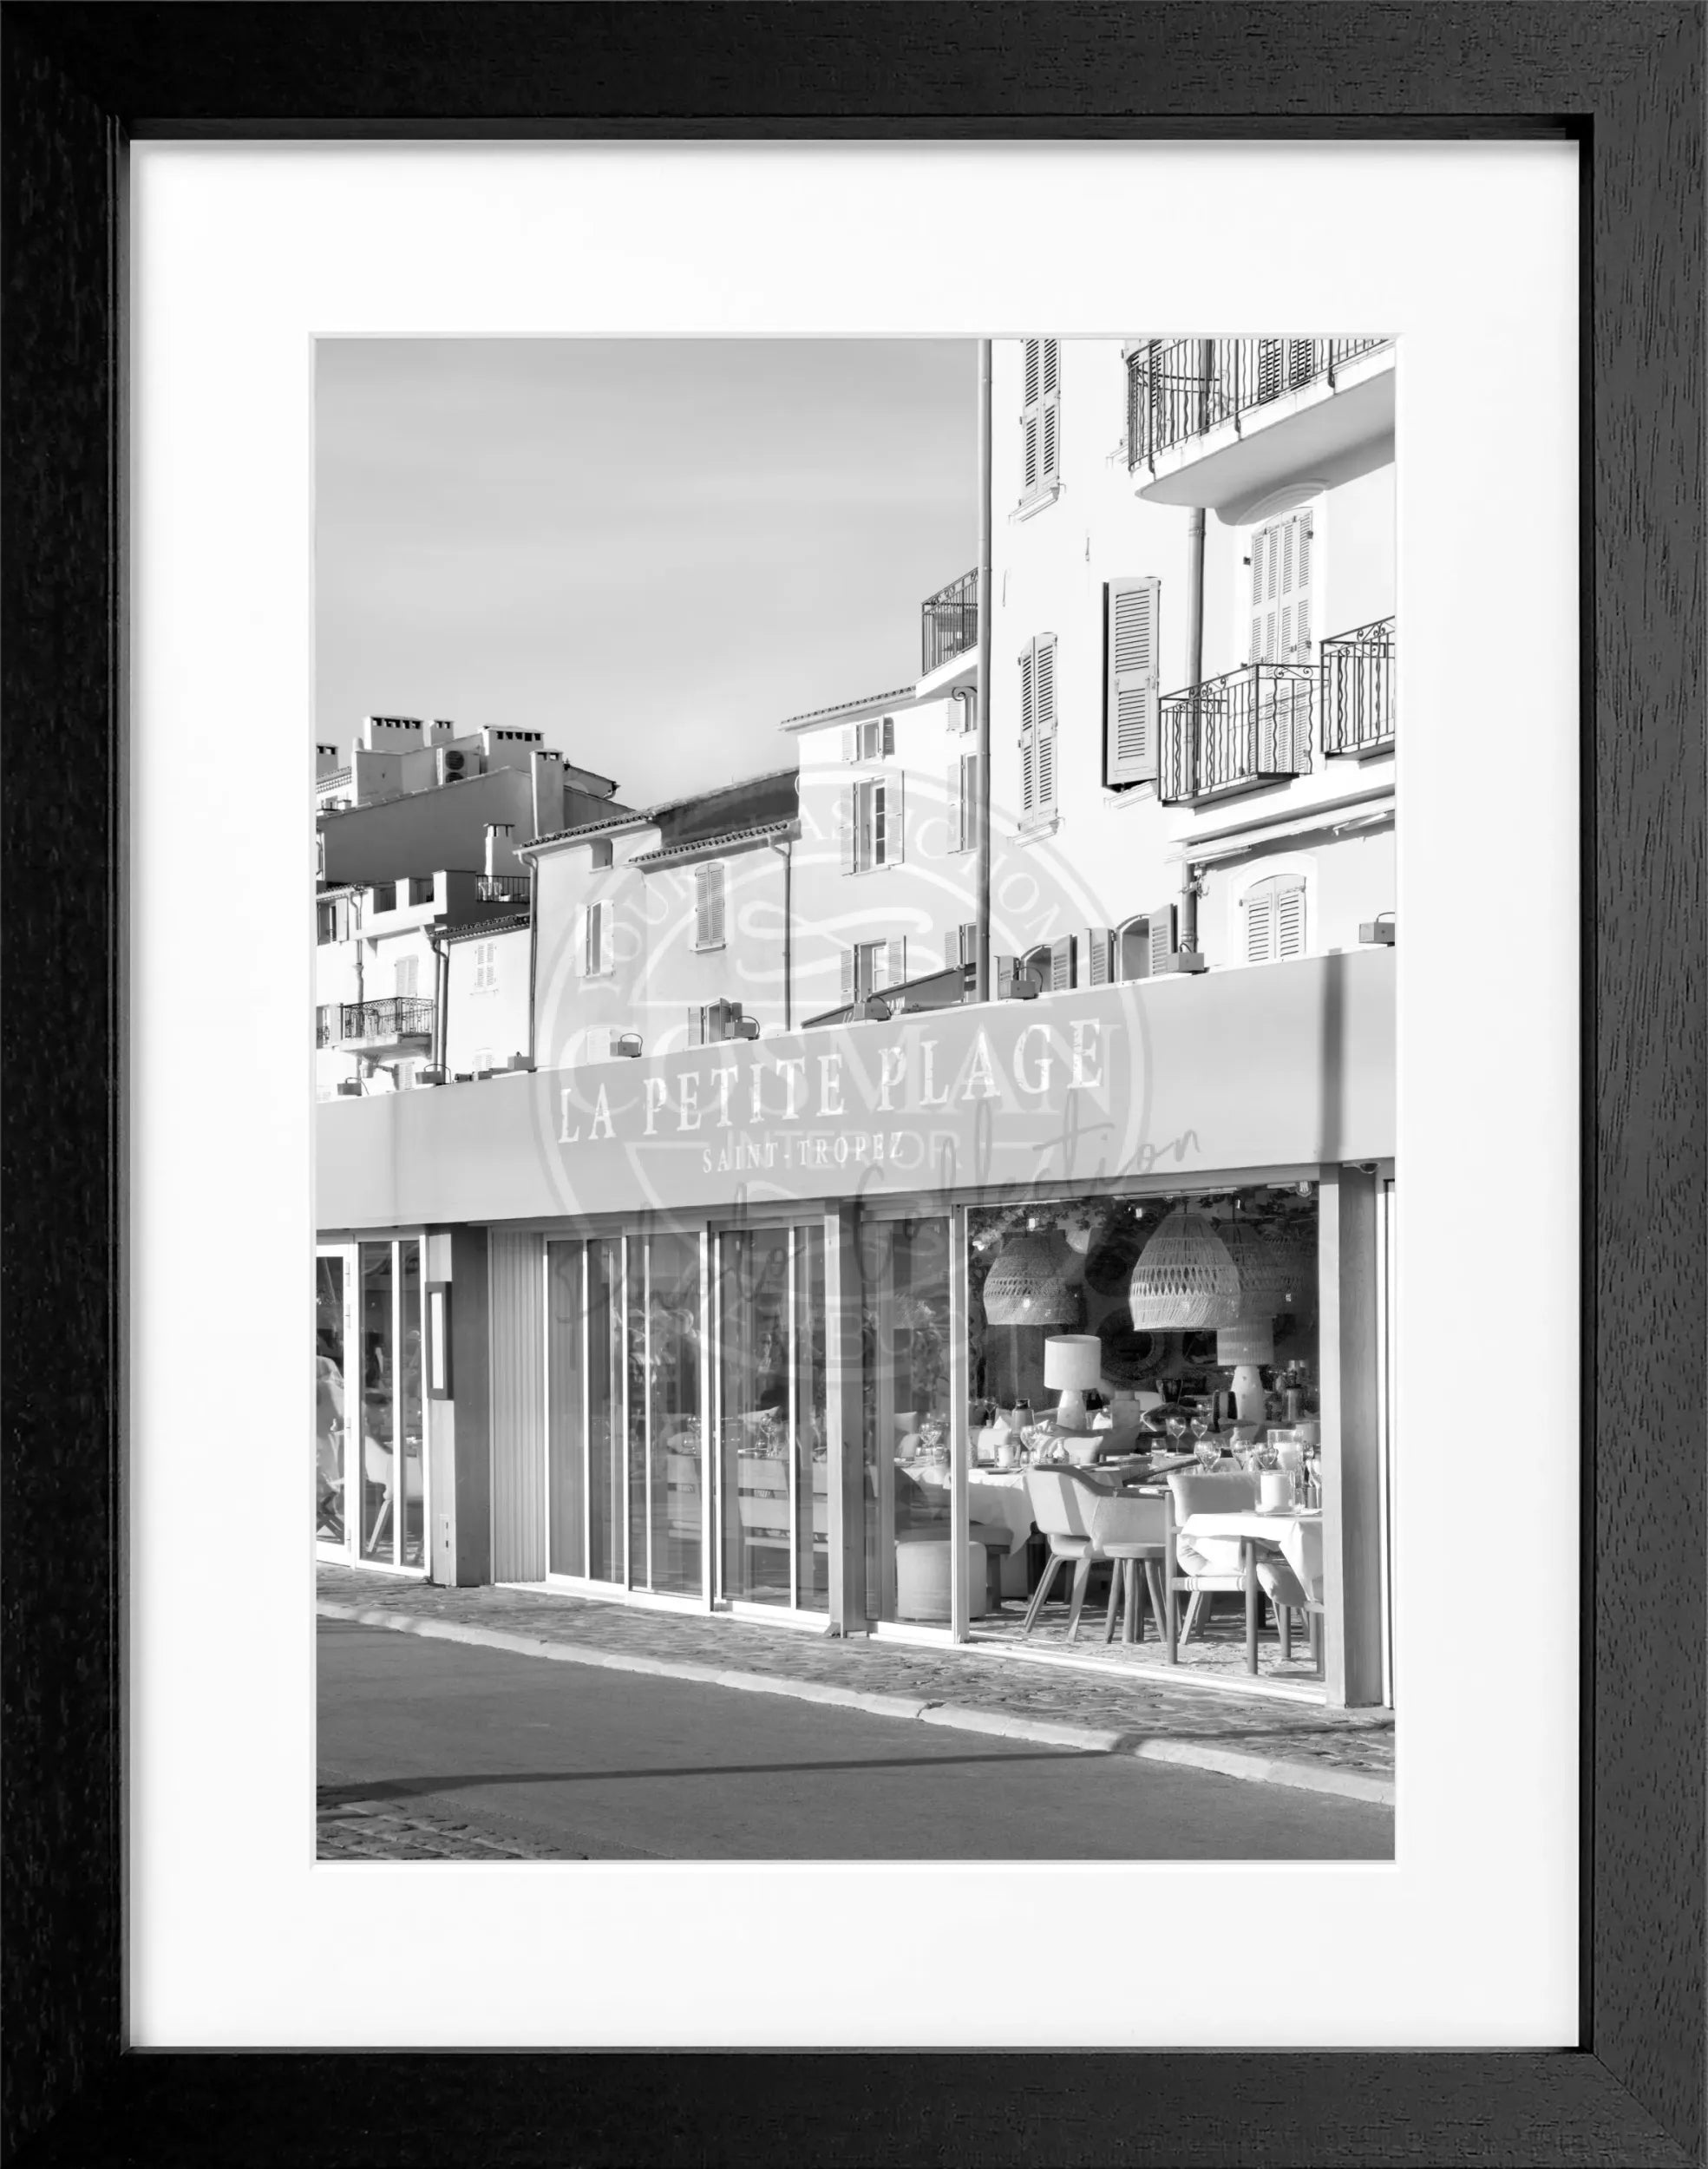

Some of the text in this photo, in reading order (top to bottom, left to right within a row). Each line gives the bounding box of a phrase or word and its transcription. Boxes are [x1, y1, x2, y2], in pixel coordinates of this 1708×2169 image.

[558, 1018, 1103, 1143] LA PETITE PLAGE
